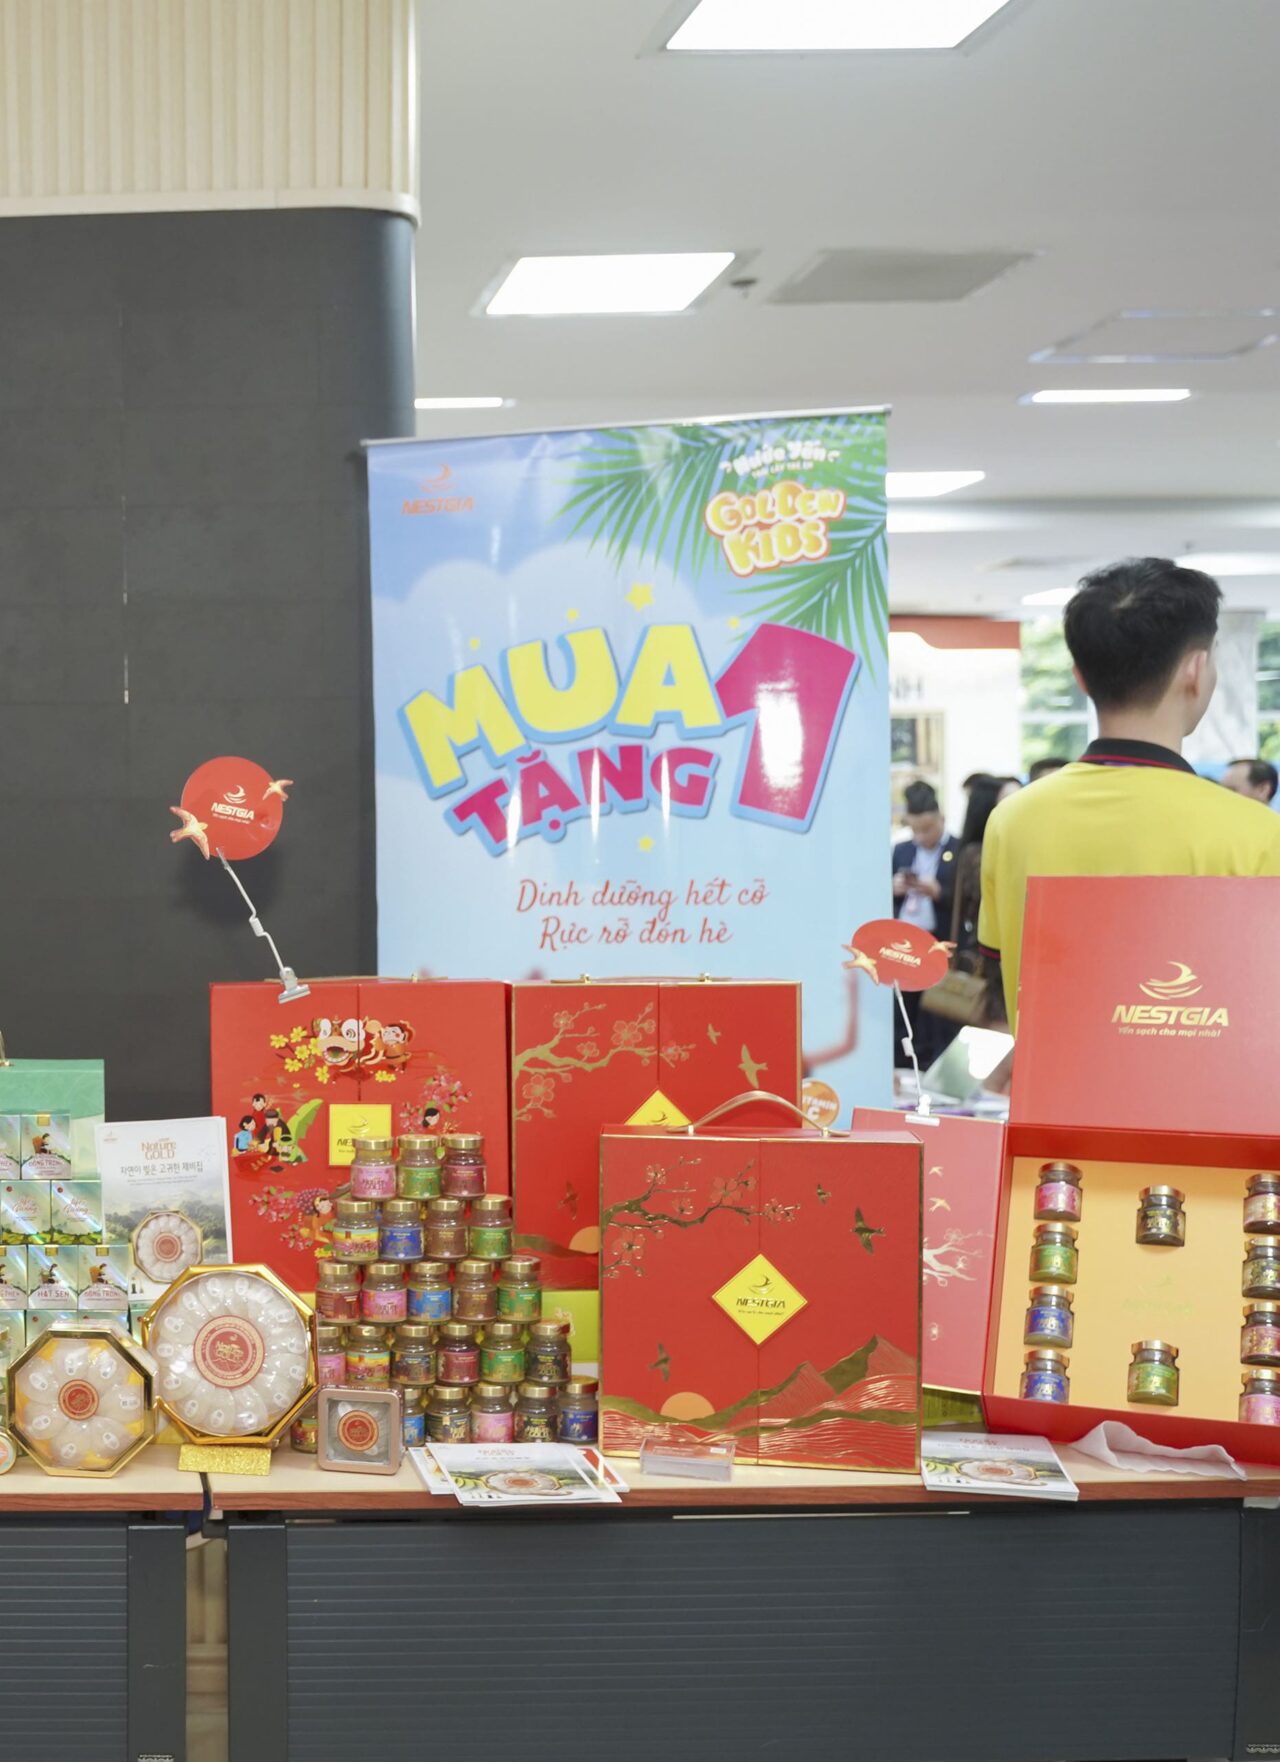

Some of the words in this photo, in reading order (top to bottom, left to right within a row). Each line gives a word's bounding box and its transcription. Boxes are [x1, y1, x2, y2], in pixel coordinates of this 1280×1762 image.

[401, 496, 475, 515] NESTGIA
[705, 480, 847, 537] GOLDEN
[722, 520, 832, 577] KIDS
[400, 623, 724, 791] MUA
[714, 622, 857, 822] 1
[211, 802, 255, 820] NESTGIA
[450, 744, 715, 845] TẶNG
[516, 879, 586, 913] Dinh
[592, 879, 678, 922] dưỡng
[685, 877, 732, 906] hết
[540, 915, 593, 952] Rực
[639, 917, 692, 944] đón
[698, 916, 734, 944] hè
[878, 947, 922, 966] NESTGIA
[1111, 1005, 1230, 1027] NESTGIA
[736, 1297, 786, 1308] NESTGIA
